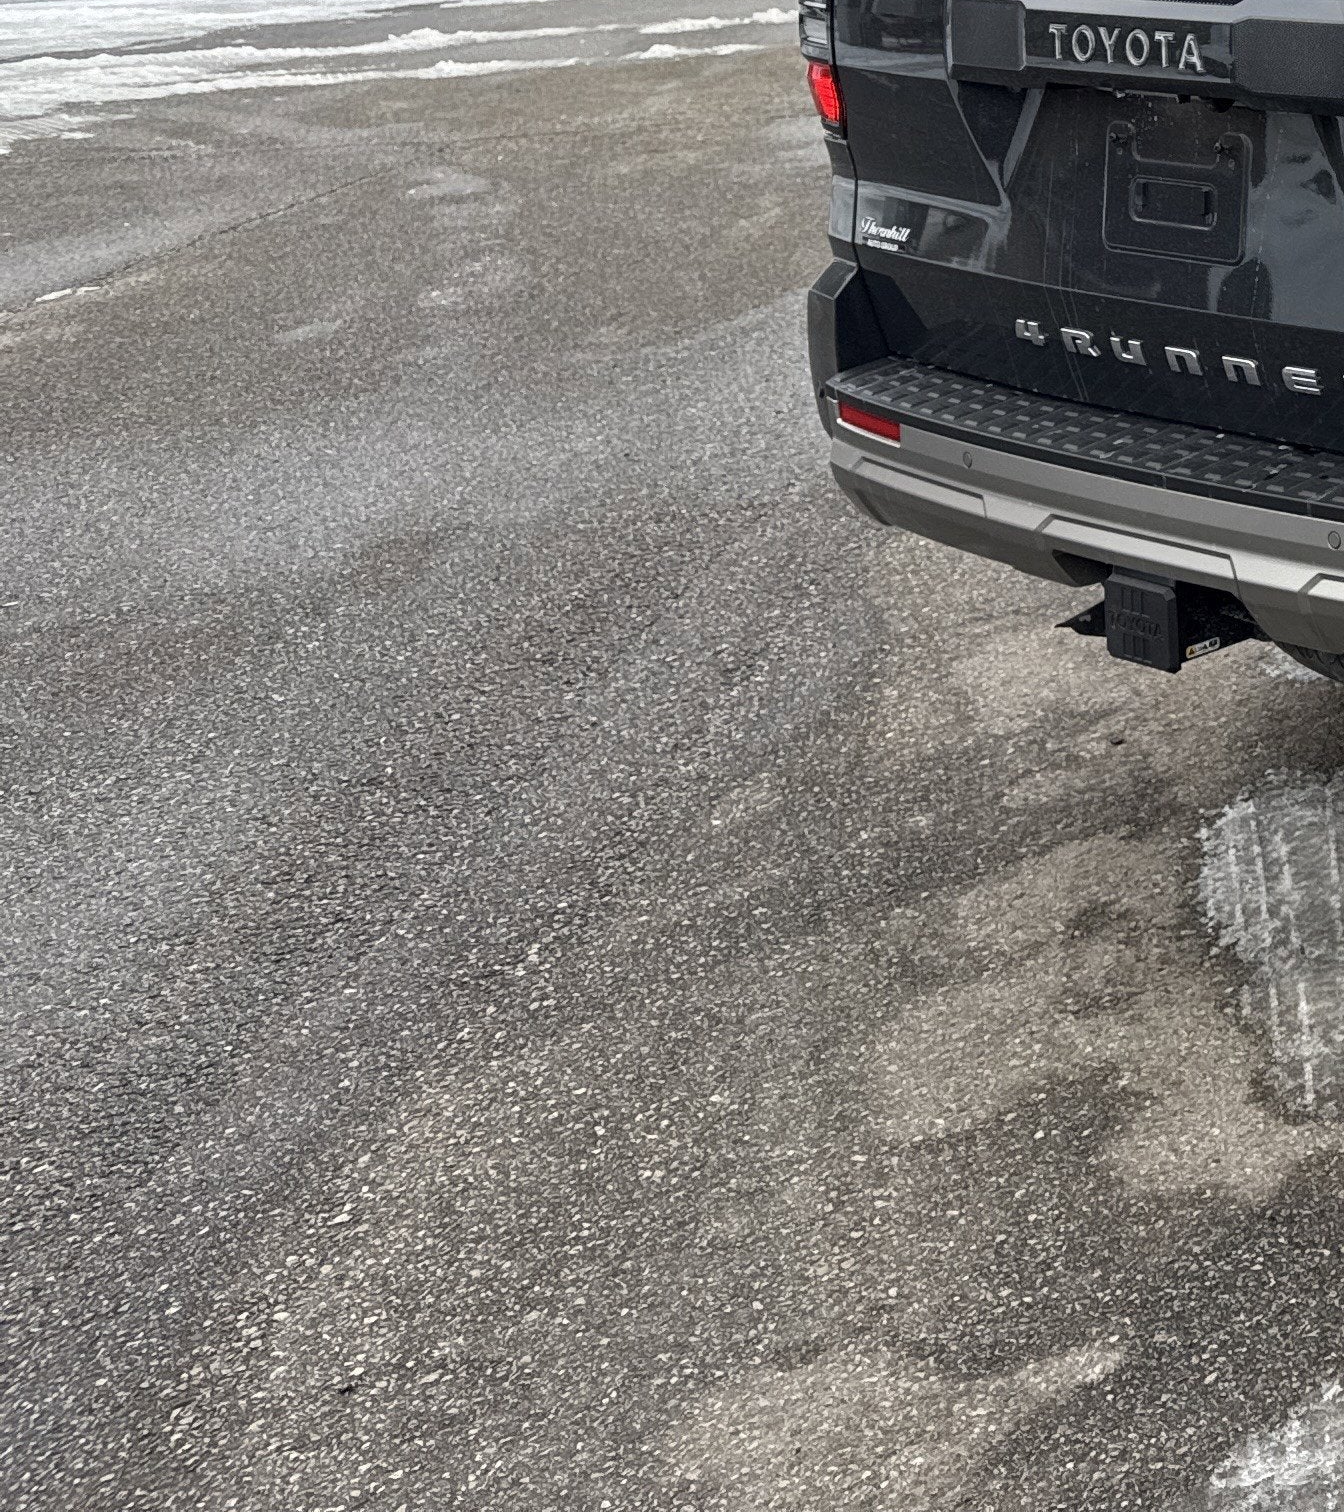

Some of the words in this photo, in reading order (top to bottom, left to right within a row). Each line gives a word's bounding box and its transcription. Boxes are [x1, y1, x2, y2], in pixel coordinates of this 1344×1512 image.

[1049, 23, 1207, 73] TOYOTA
[861, 216, 911, 243] Thornhill
[1110, 610, 1162, 637] TOYOTA
